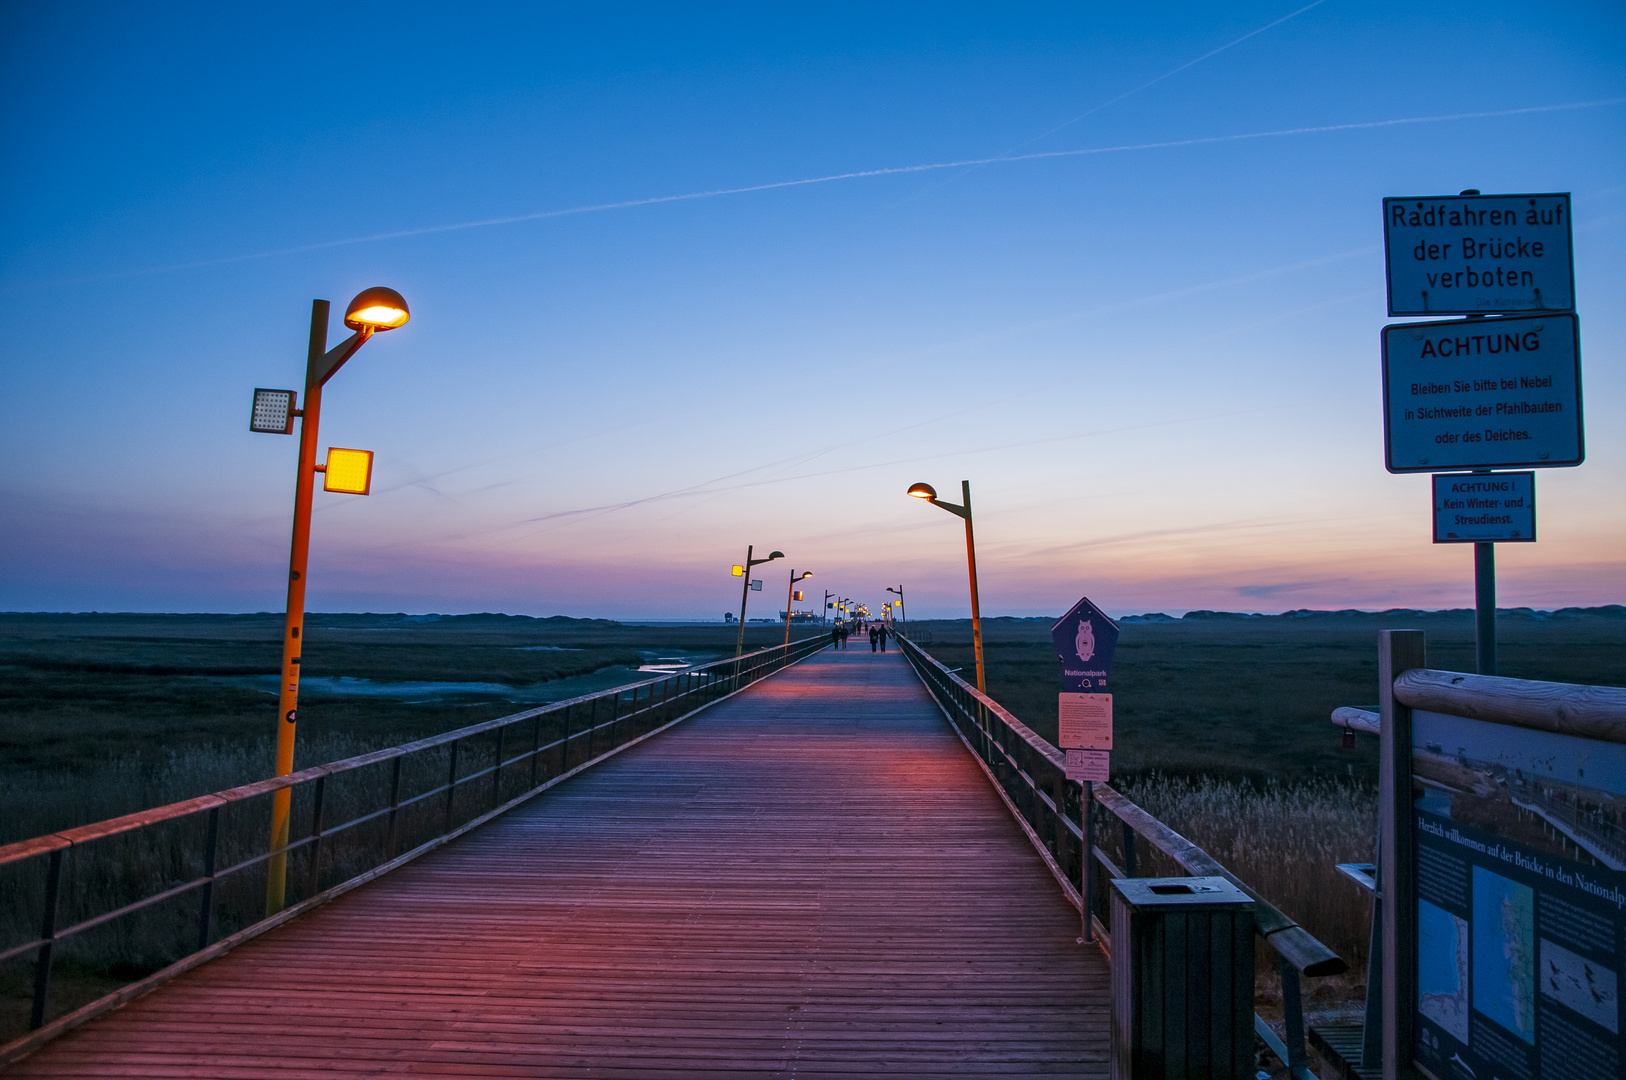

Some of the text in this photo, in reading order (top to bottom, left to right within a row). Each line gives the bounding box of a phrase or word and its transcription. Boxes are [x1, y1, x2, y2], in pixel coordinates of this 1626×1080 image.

[1392, 203, 1564, 227] Radfahren auf
[1413, 236, 1544, 261] der Brücke
[1426, 265, 1534, 288] verboten
[1420, 332, 1540, 358] ACHTUNG
[1411, 375, 1552, 395] Bleiben Sie bitte bei Nebel
[1404, 401, 1562, 420] in Sichtweite der Pfahlbauten
[1435, 428, 1532, 444] oder des Deiches.
[1451, 481, 1509, 493] ACHTUNG
[1444, 496, 1524, 509] Kein Winter- und
[1454, 514, 1513, 525] Streudienst.
[1064, 669, 1107, 677] Nationalpark
[1418, 817, 1626, 910] Herzlich willkommen auf der Brücke in den Nationalp
